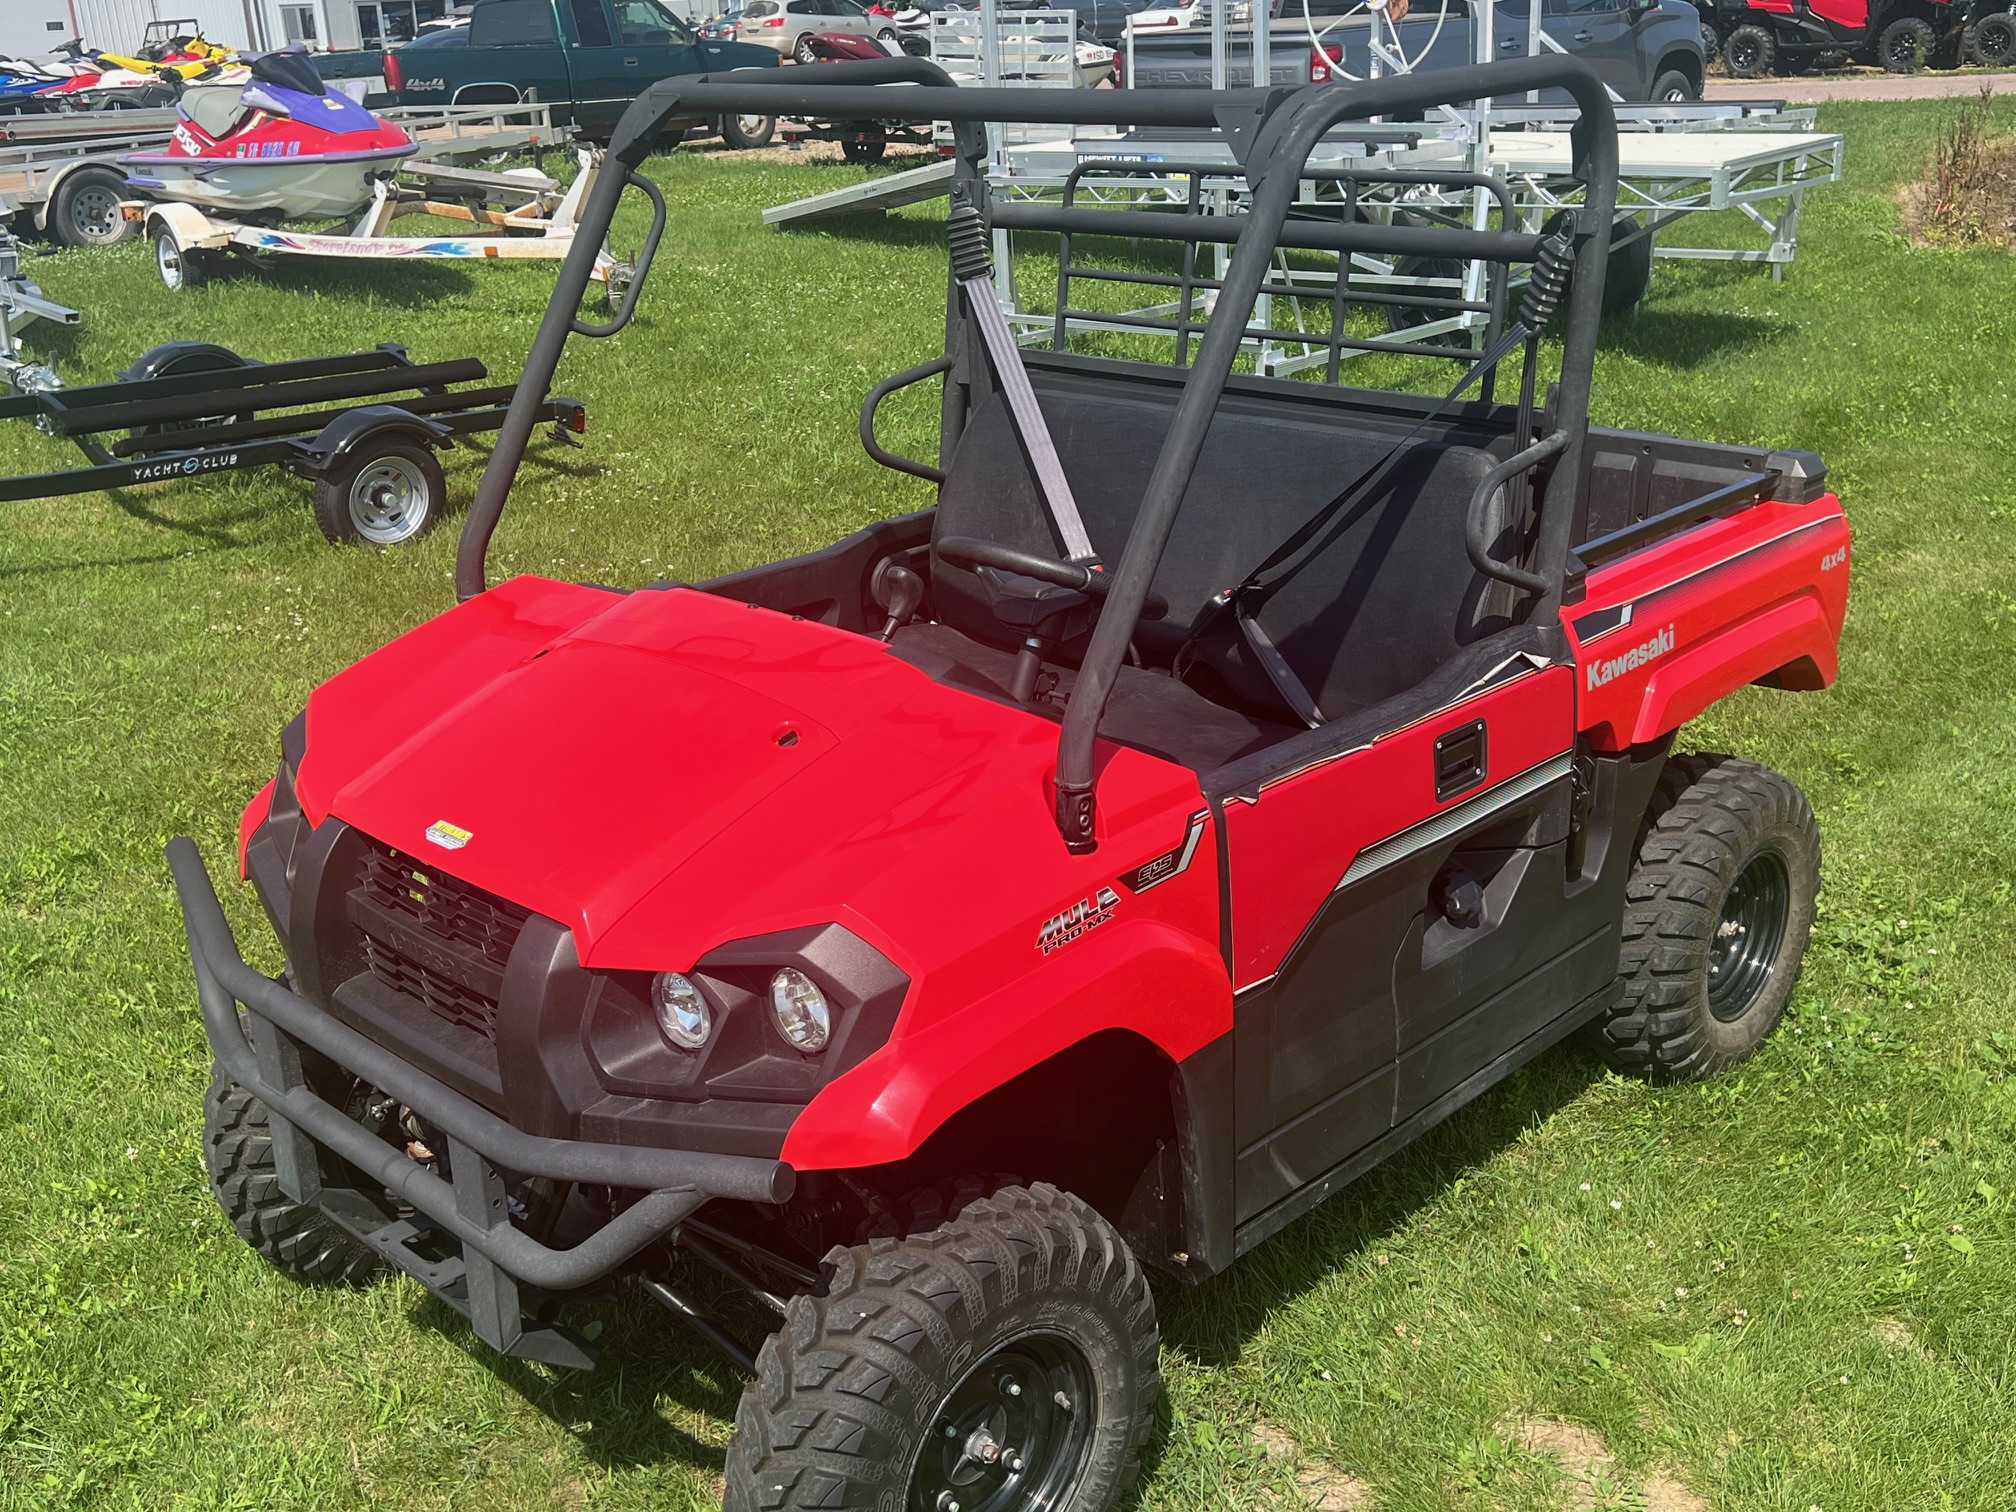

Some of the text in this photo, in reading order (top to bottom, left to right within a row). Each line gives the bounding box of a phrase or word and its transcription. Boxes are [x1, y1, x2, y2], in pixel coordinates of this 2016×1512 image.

[405, 77, 446, 91] 4x4
[1132, 68, 1294, 83] CHEVROLT
[134, 453, 239, 480] YACHT CLUB
[1820, 546, 1846, 572] 4x4
[1586, 623, 1675, 692] Kawasaki
[1137, 853, 1173, 883] EPS
[1034, 885, 1122, 950] MULE
[1043, 906, 1116, 957] PRO-MX
